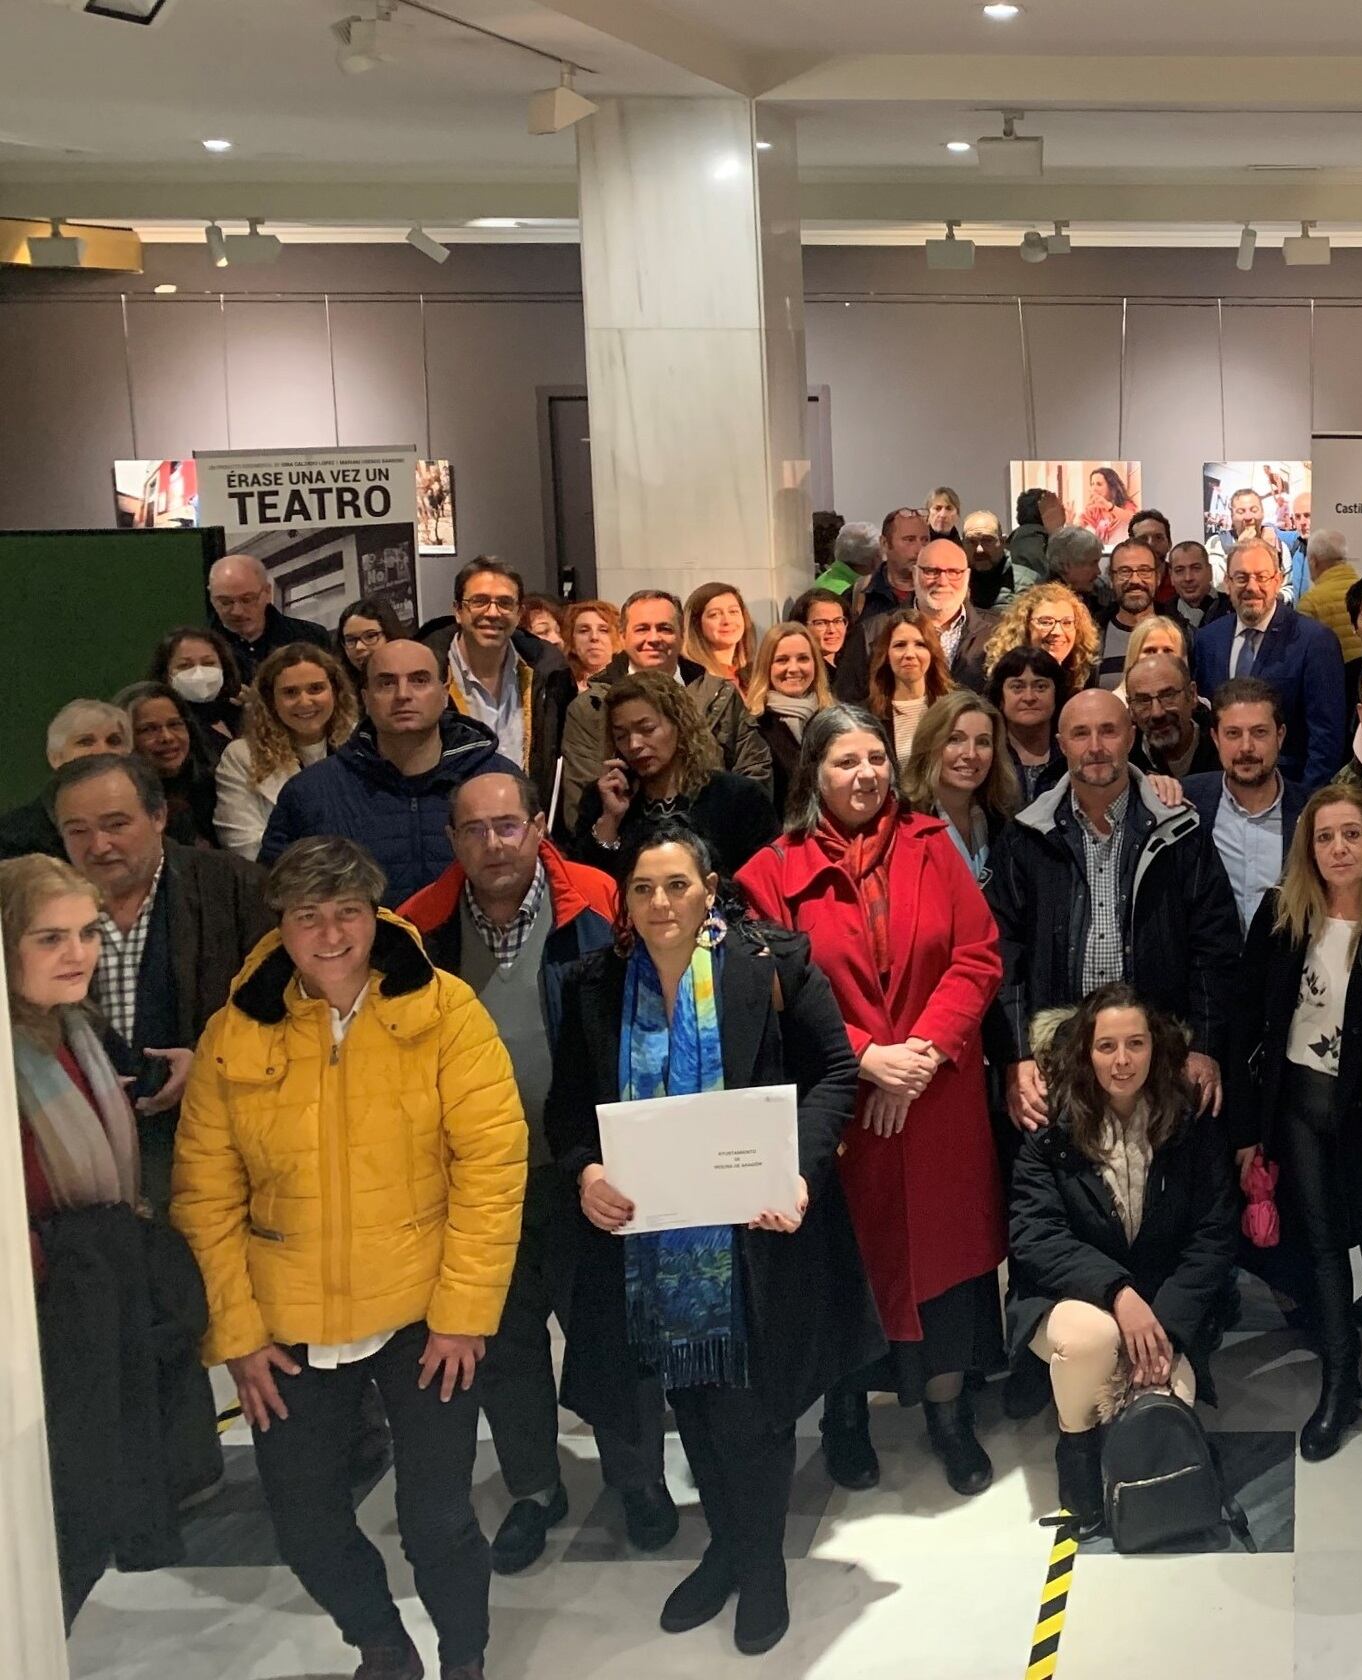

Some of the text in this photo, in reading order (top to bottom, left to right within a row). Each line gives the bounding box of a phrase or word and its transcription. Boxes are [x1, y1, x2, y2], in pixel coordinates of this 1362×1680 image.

[227, 468, 389, 488] ÉRASE UNA VEZ UN
[228, 485, 391, 525] TEATRO
